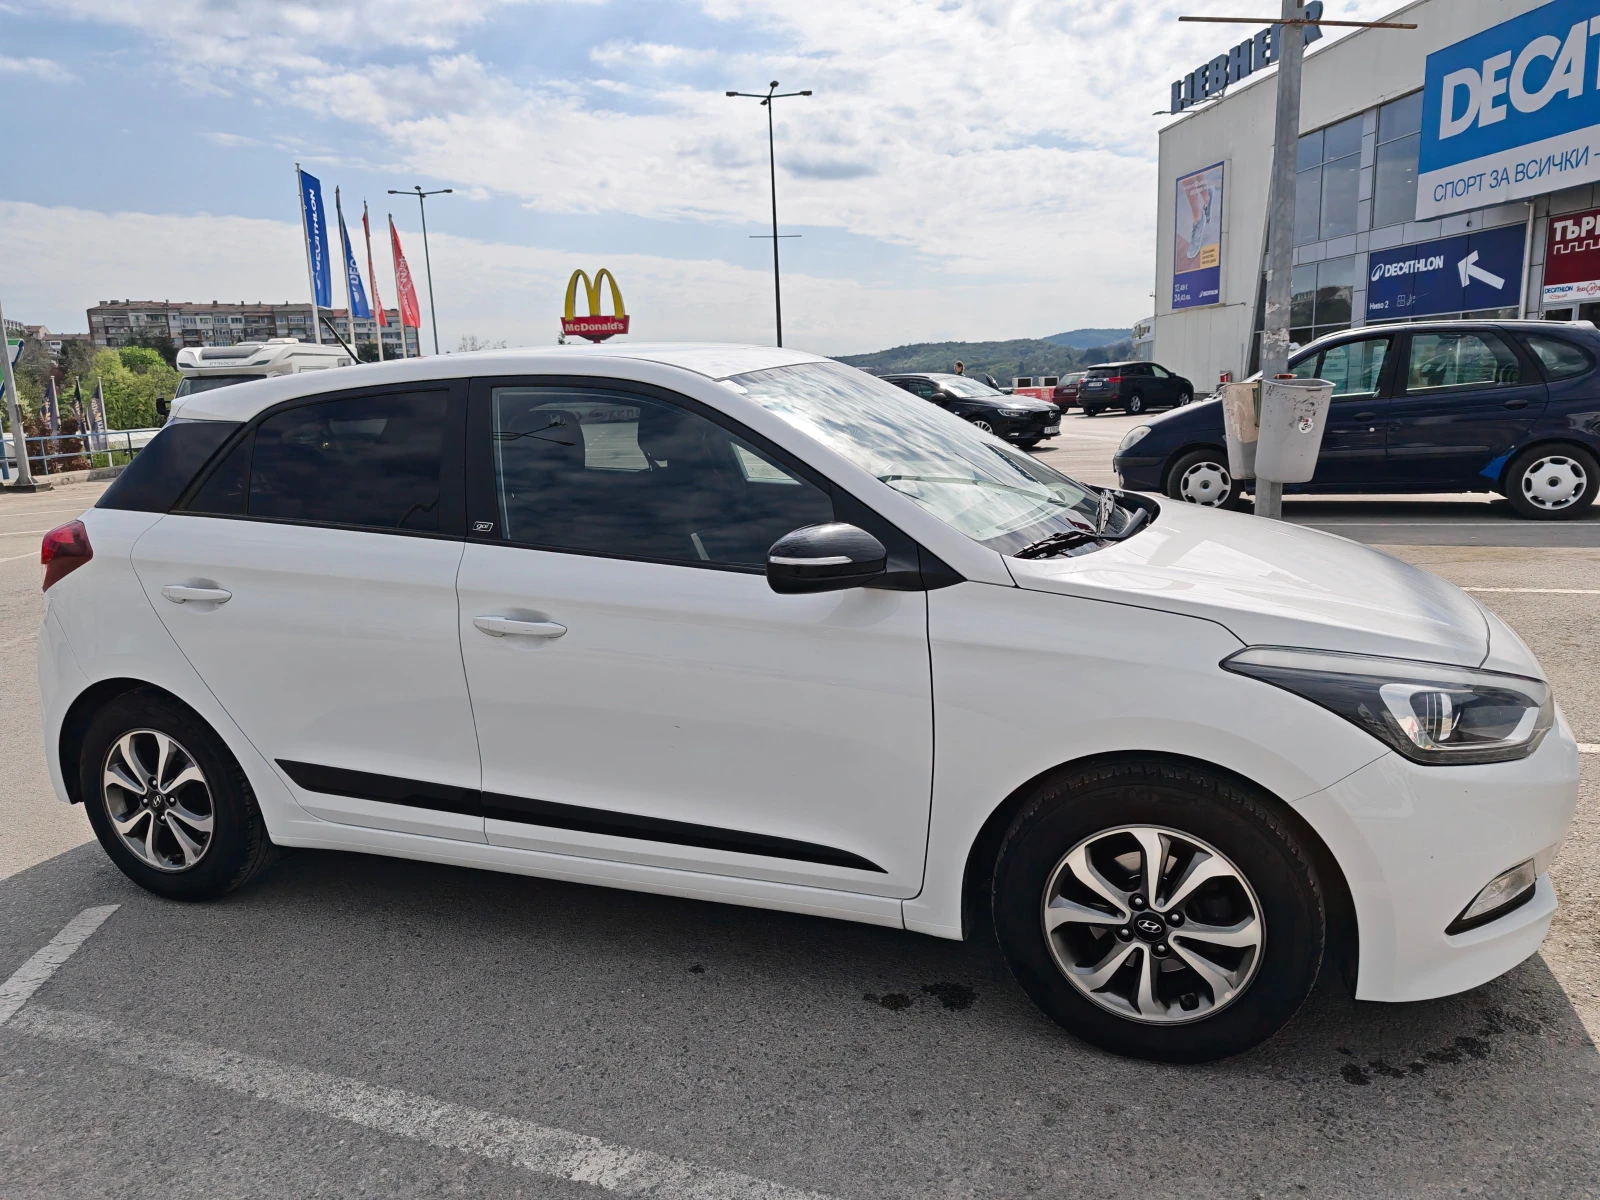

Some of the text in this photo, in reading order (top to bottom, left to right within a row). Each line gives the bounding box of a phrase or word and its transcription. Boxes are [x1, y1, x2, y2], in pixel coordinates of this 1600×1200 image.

[1433, 145, 1589, 202] СПОРТ ЗА ВСИЧКИ
[1384, 255, 1444, 278] DECATHLON
[1544, 285, 1573, 294] DECATHLON
[1384, 300, 1389, 309] 2
[565, 322, 624, 332] McDonald's
